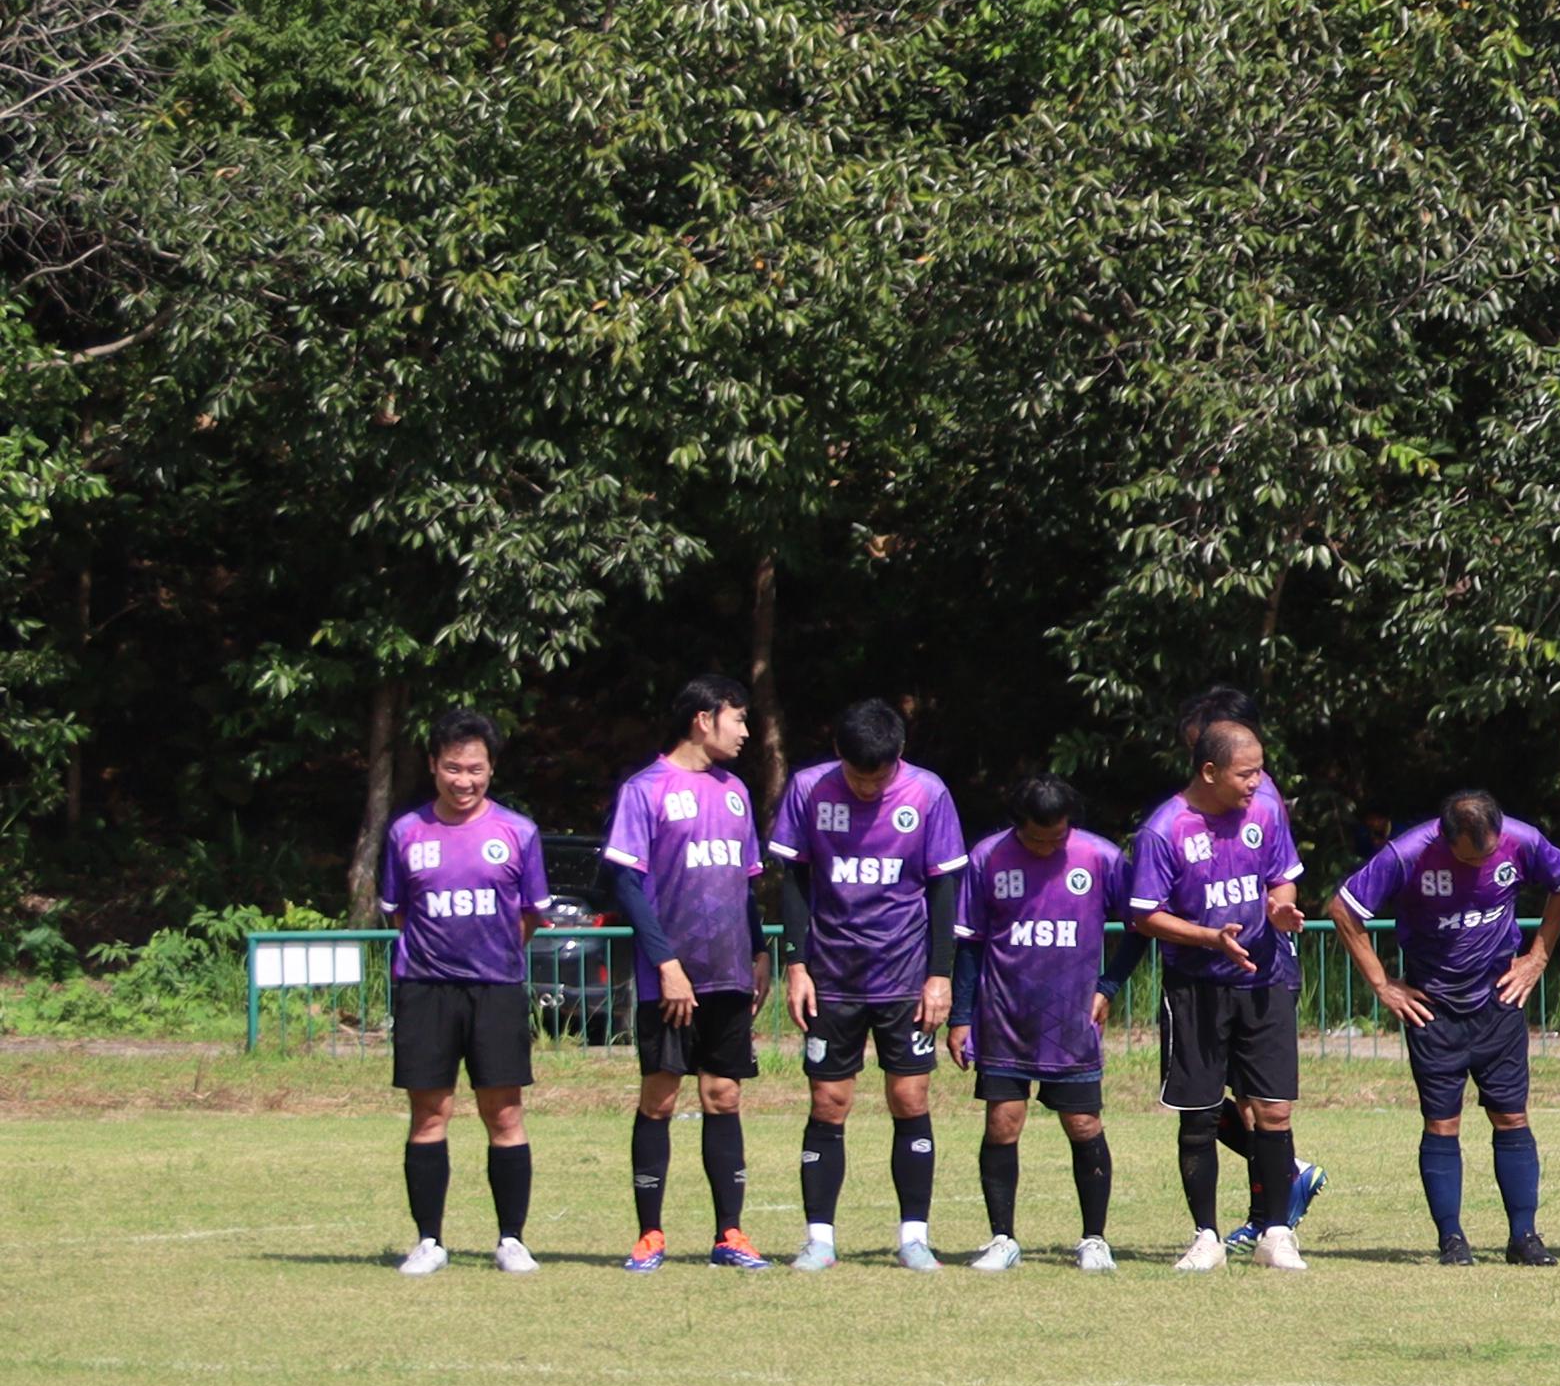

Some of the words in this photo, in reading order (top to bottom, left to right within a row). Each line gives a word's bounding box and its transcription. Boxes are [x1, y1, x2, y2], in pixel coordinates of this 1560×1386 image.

[831, 856, 903, 885] MSH
[426, 888, 497, 918] MSH
[1204, 874, 1259, 910] MSH
[1010, 920, 1077, 947] MSH
